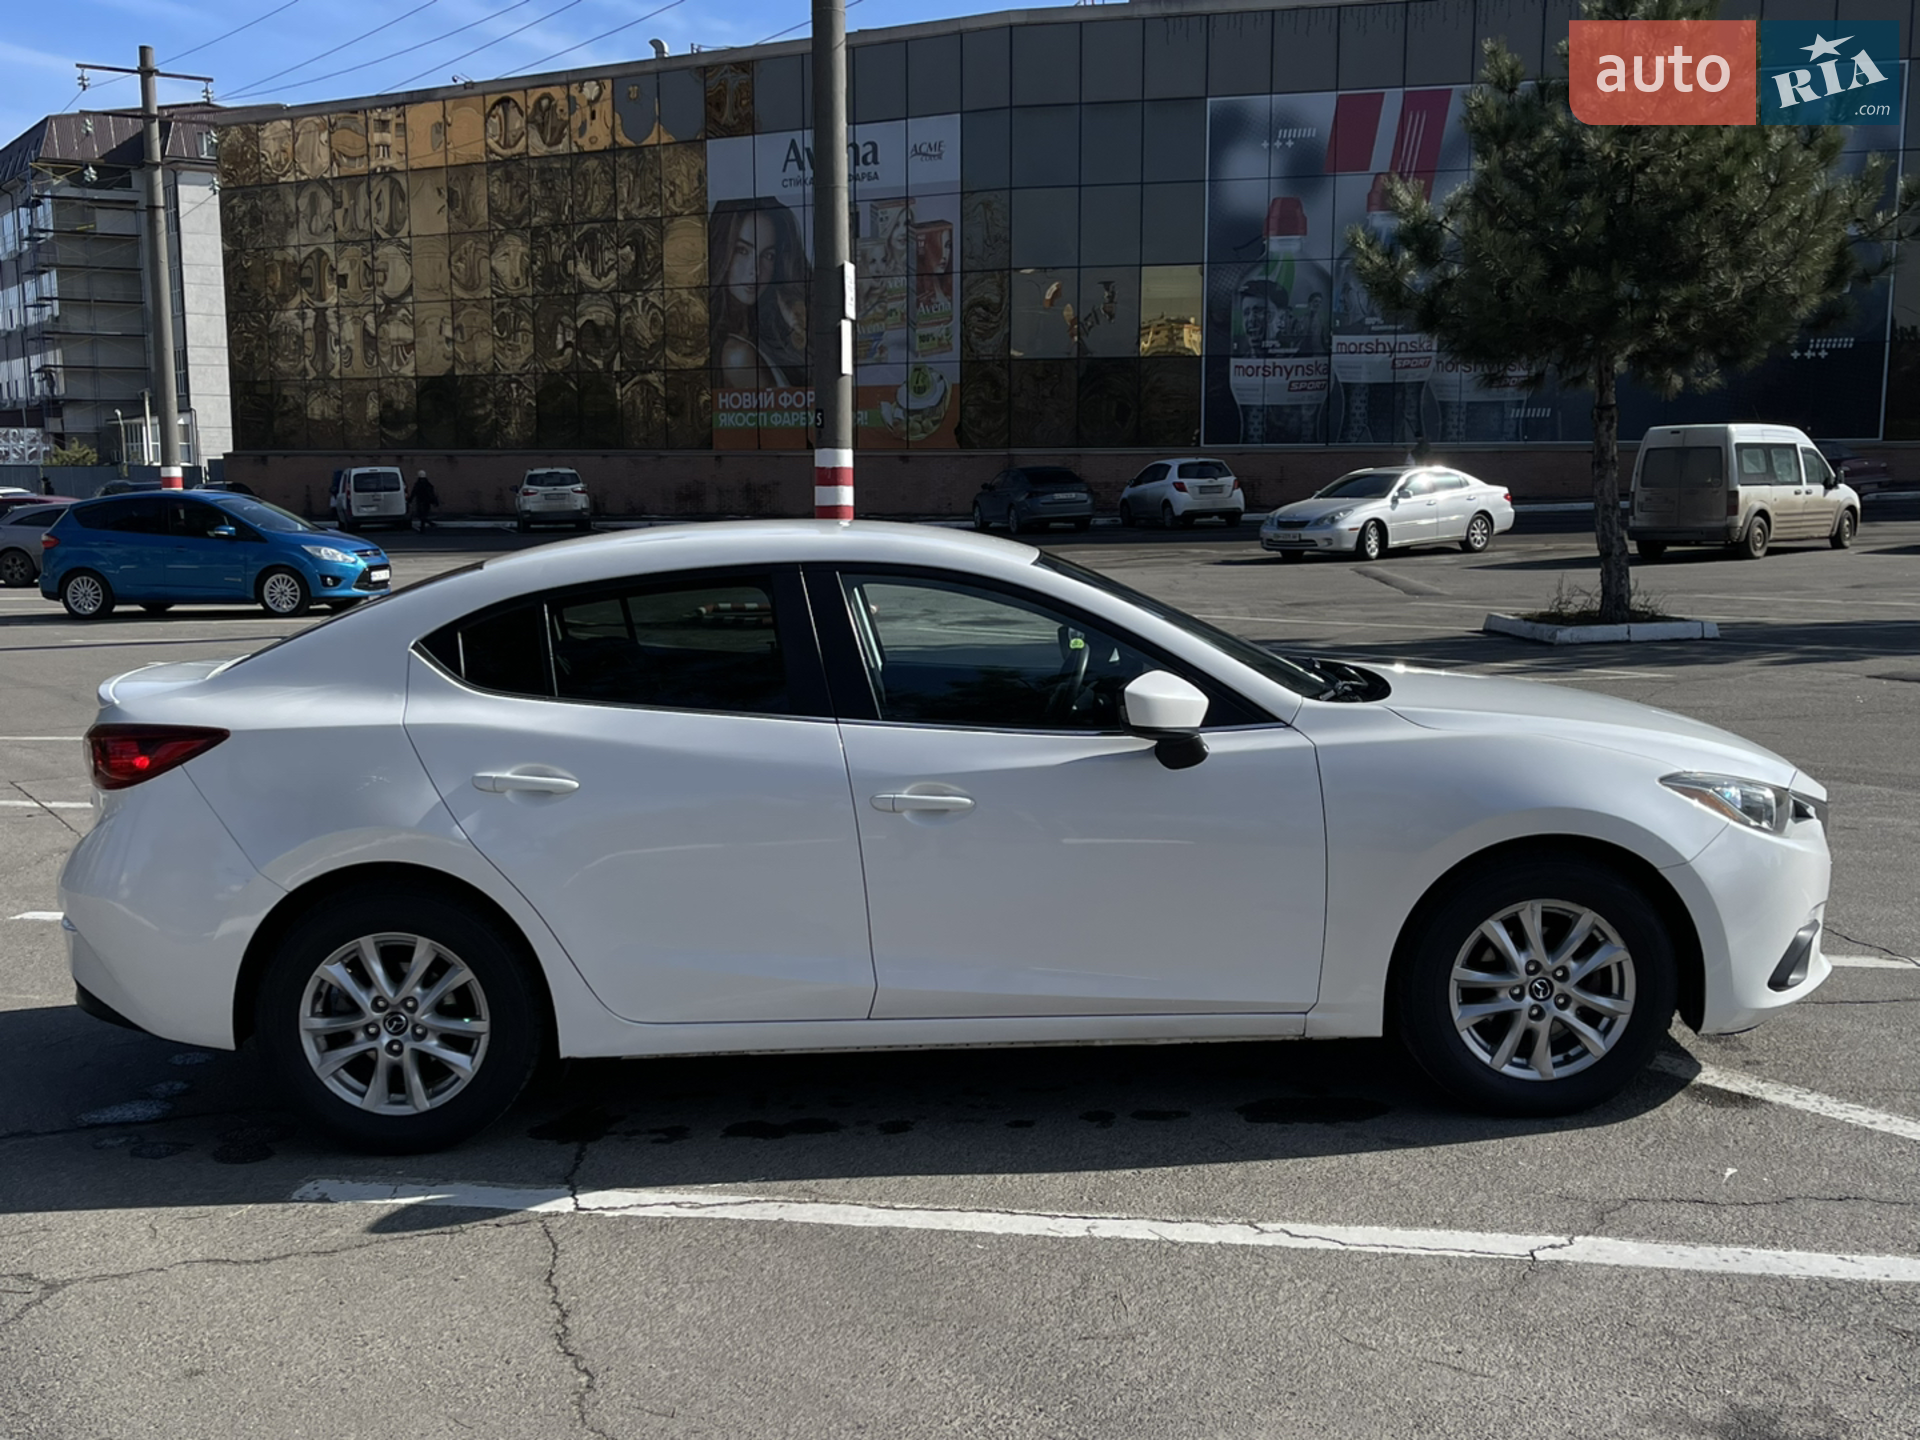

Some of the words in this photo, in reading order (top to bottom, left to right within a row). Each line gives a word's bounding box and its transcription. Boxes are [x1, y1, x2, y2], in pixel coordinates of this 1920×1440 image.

[782, 138, 880, 173] Avna
[910, 140, 945, 155] ACME
[1336, 338, 1432, 358] morshynska
[1234, 360, 1329, 381] morshynska
[1394, 358, 1431, 368] SPORT
[1290, 381, 1327, 391] SPORT
[718, 387, 775, 409] НОВИЙ
[718, 412, 768, 427] ЯКОСТІ
